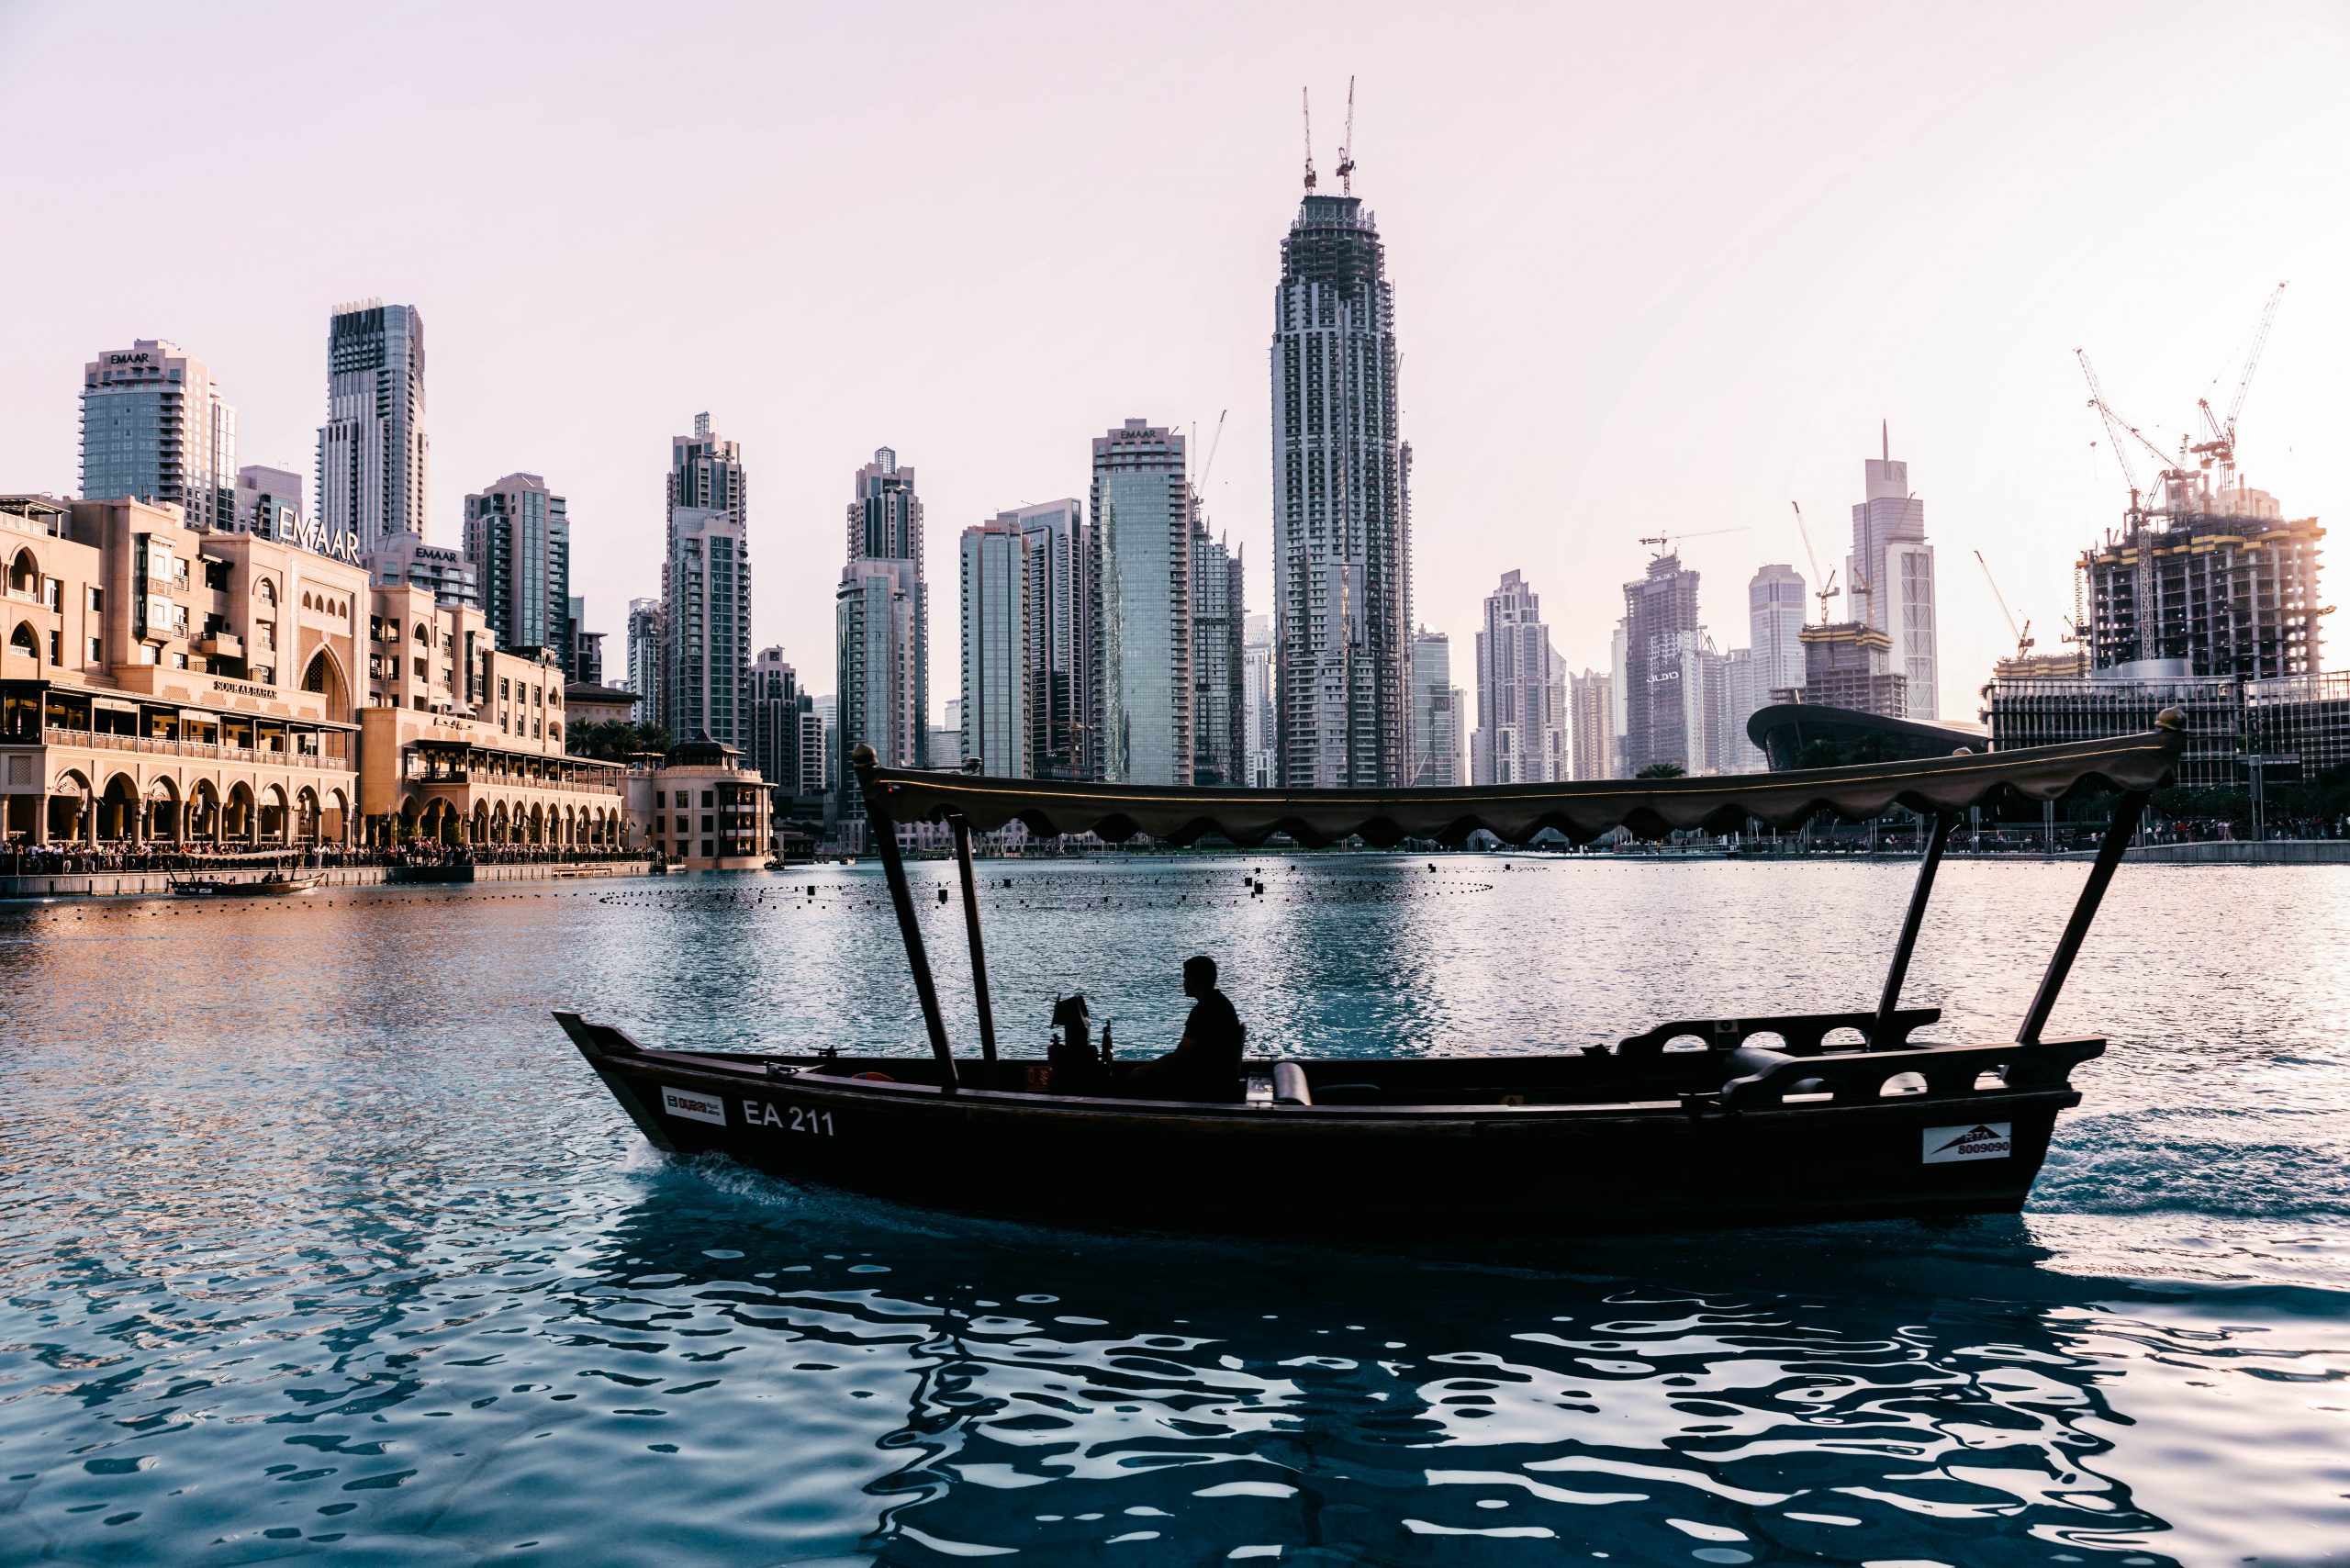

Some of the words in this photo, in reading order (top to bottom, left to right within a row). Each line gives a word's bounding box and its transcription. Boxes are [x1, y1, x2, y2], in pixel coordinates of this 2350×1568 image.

[111, 353, 150, 364] EMAAR
[1121, 430, 1157, 439] EMAAR
[278, 506, 361, 565] EMAAR
[416, 547, 457, 563] EMAAR
[743, 1100, 783, 1128] EA
[789, 1106, 834, 1137] 211
[1964, 1131, 1990, 1142] RTA
[1958, 1142, 2009, 1155] 8009090
